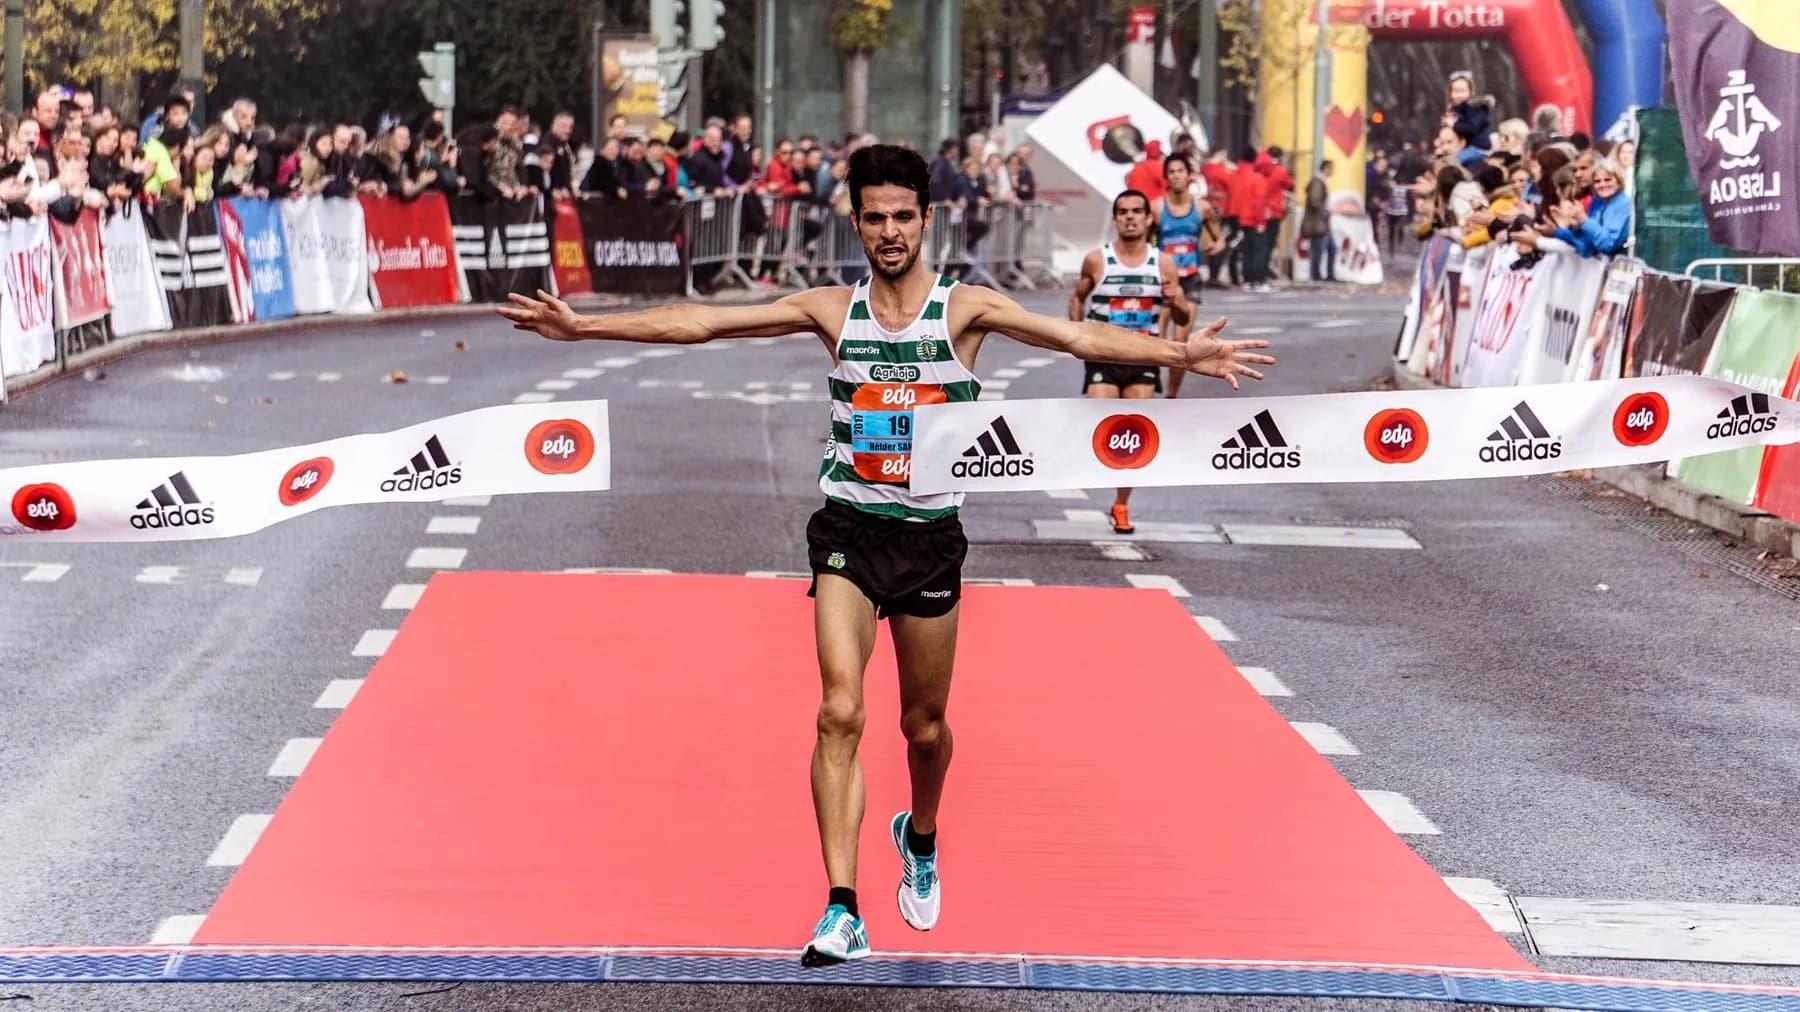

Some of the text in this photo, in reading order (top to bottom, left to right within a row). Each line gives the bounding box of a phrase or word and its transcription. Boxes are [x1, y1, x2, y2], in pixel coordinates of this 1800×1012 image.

[1420, 0, 1504, 28] Totta
[420, 236, 448, 268] Totta
[846, 346, 880, 355] macron
[874, 366, 916, 380] Agriloja
[882, 384, 917, 409] edp
[854, 414, 864, 436] 2017
[888, 415, 910, 436] 19
[1626, 406, 1655, 431] edp
[1707, 411, 1778, 440] adidas
[541, 434, 576, 459] edp
[1108, 430, 1141, 454] edp
[1380, 423, 1412, 448] edp
[1211, 445, 1301, 471] adidas
[1479, 438, 1562, 463] adidas
[951, 453, 1034, 478] adidas
[291, 468, 319, 490] edp
[380, 465, 463, 493] adidas
[27, 497, 60, 520] edp
[130, 504, 215, 530] adidas
